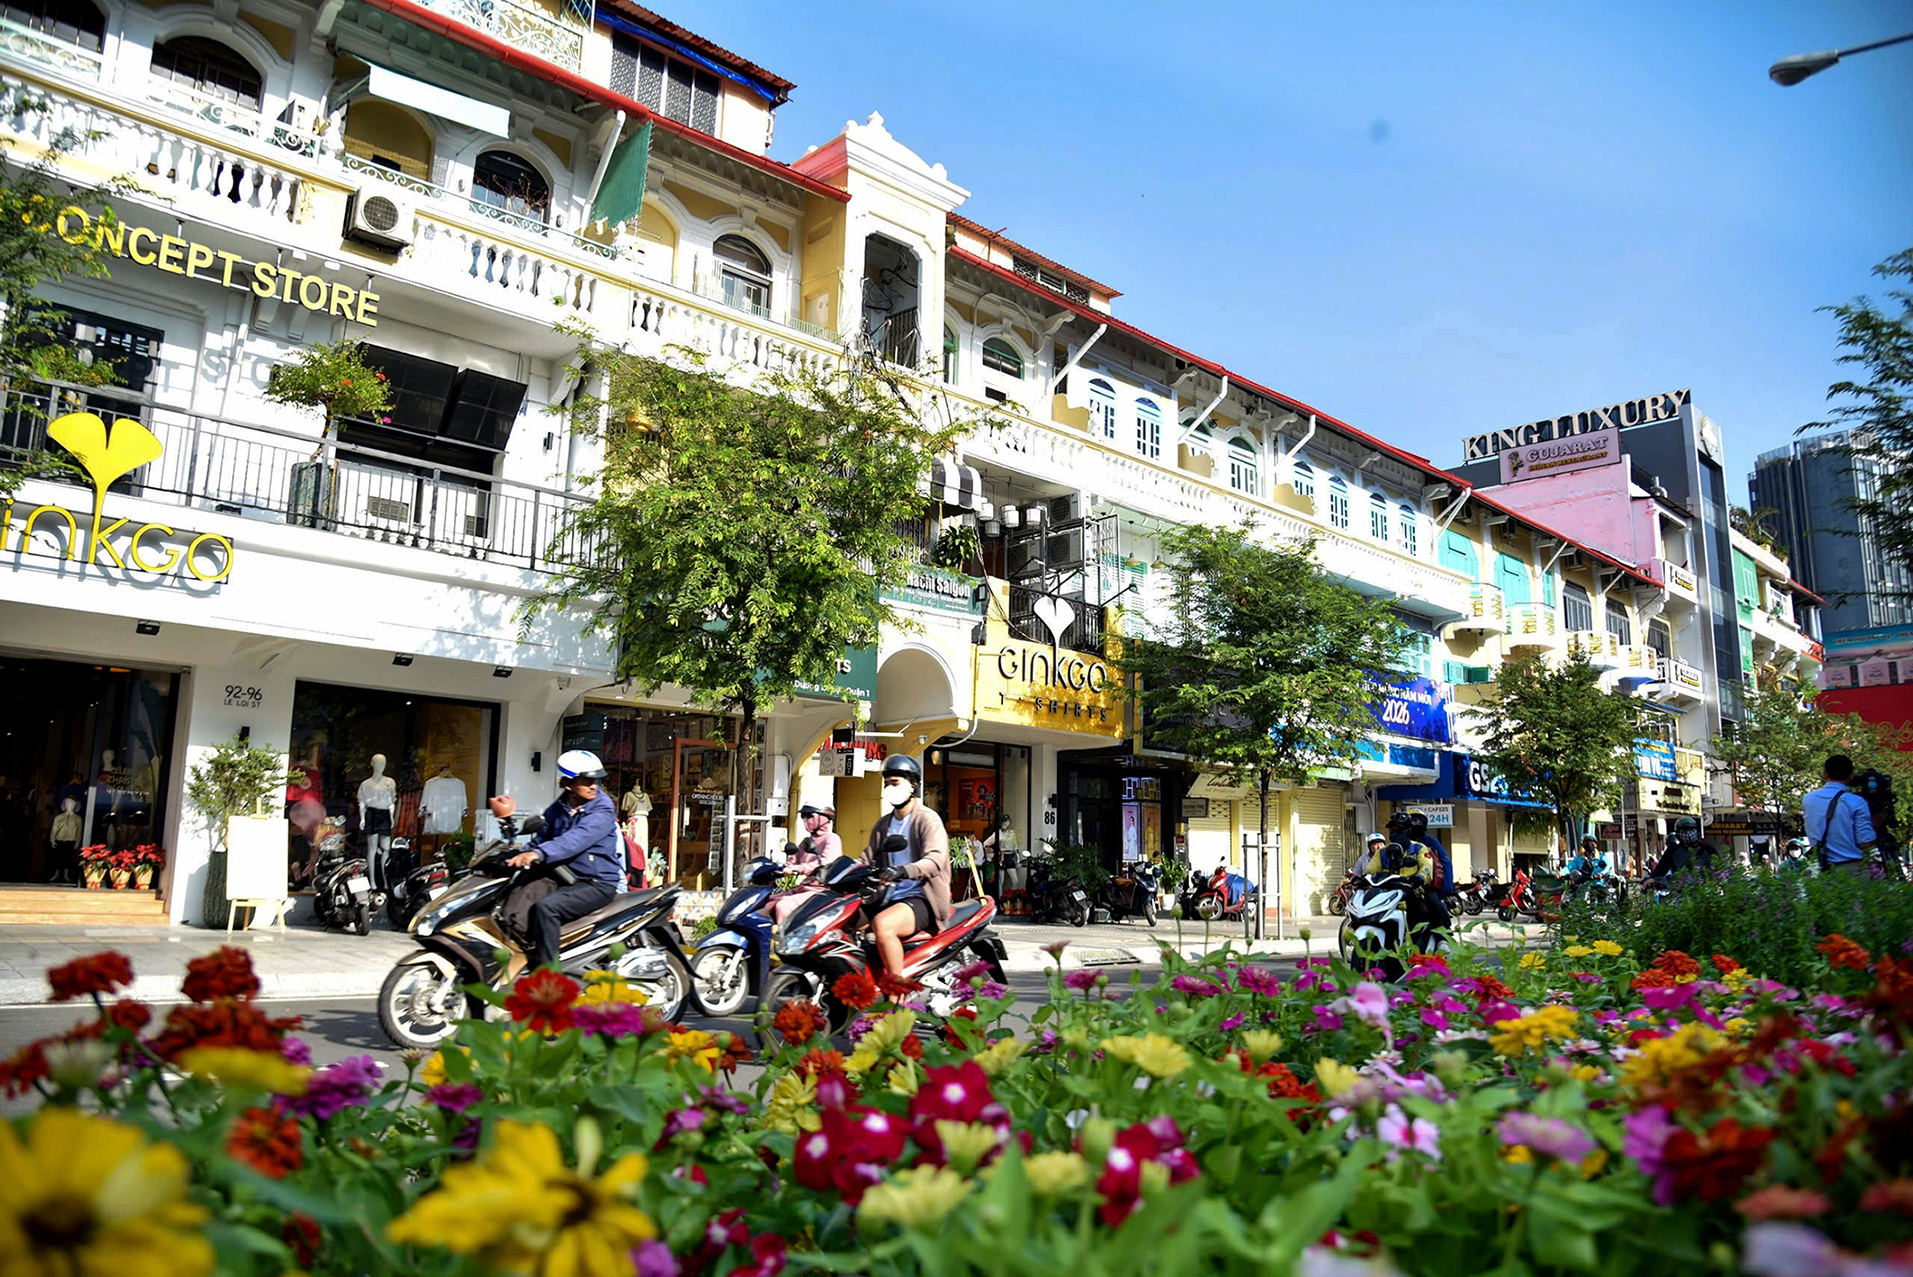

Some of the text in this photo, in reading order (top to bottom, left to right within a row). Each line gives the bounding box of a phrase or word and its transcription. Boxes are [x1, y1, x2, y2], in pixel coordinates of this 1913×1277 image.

[251, 261, 381, 327] STORE
[1461, 388, 1692, 461] KING LUXURY
[1525, 436, 1609, 463] GUJARAT
[936, 576, 971, 600] Saigon
[224, 684, 263, 701] 92-96
[251, 701, 262, 709] ST
[1382, 698, 1410, 725] 2026
[1044, 811, 1055, 825] 86
[1429, 814, 1449, 823] 24H
